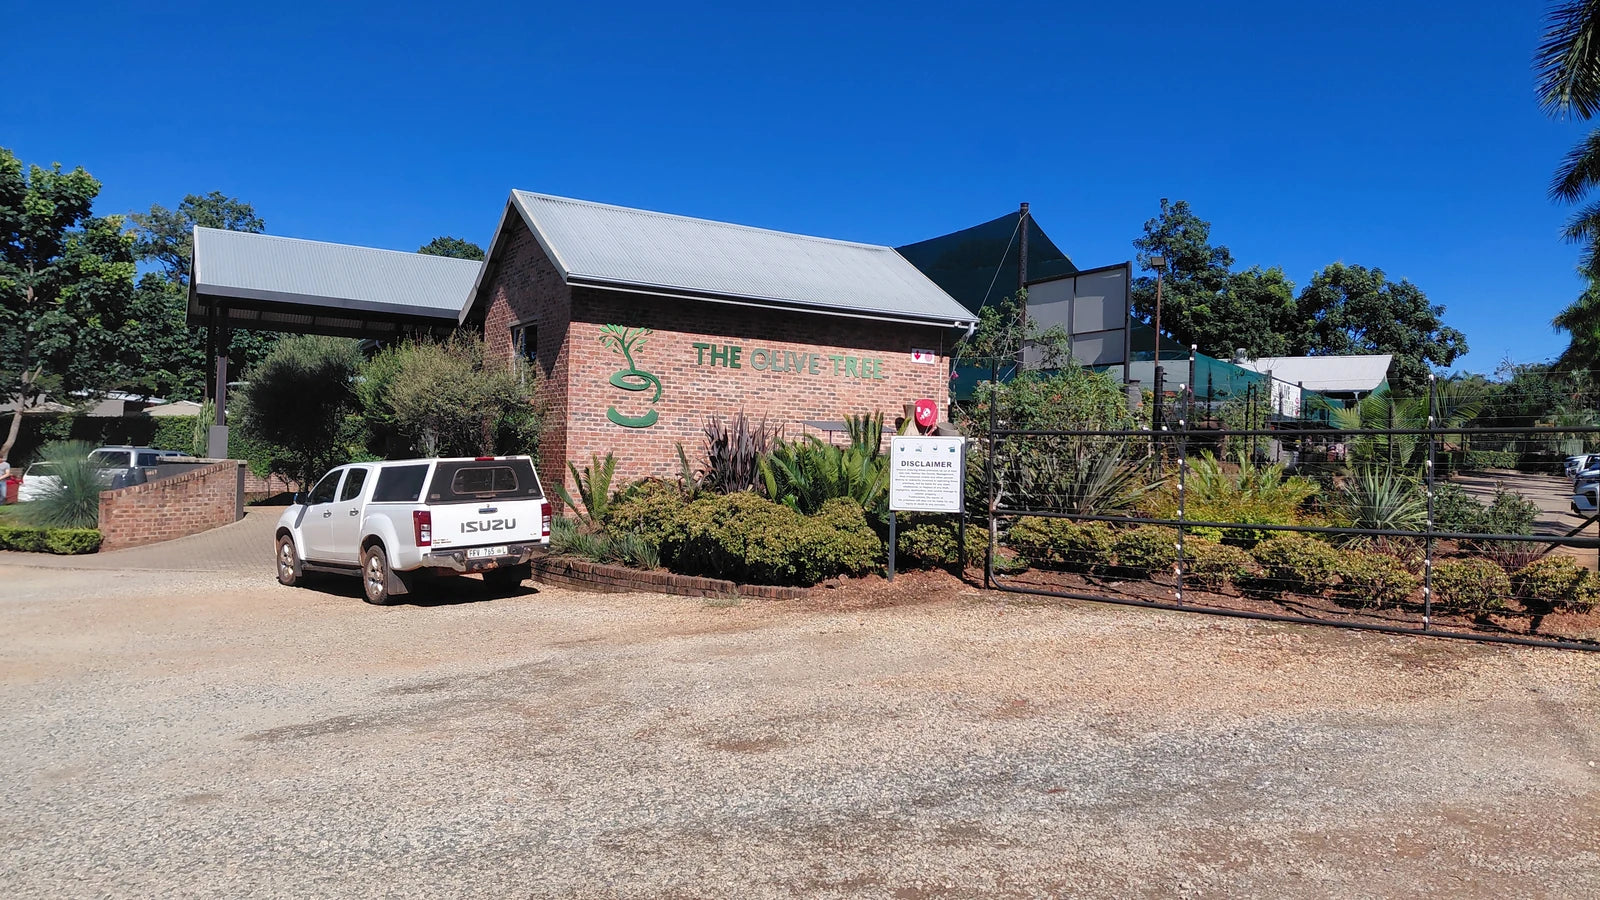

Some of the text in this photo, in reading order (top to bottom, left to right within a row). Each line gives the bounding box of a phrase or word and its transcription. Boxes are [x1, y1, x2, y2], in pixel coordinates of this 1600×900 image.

[693, 342, 884, 380] THE OLIVE TREE
[901, 460, 952, 468] DISCLAIMER
[461, 518, 516, 533] ISUZU
[484, 547, 494, 555] 765
